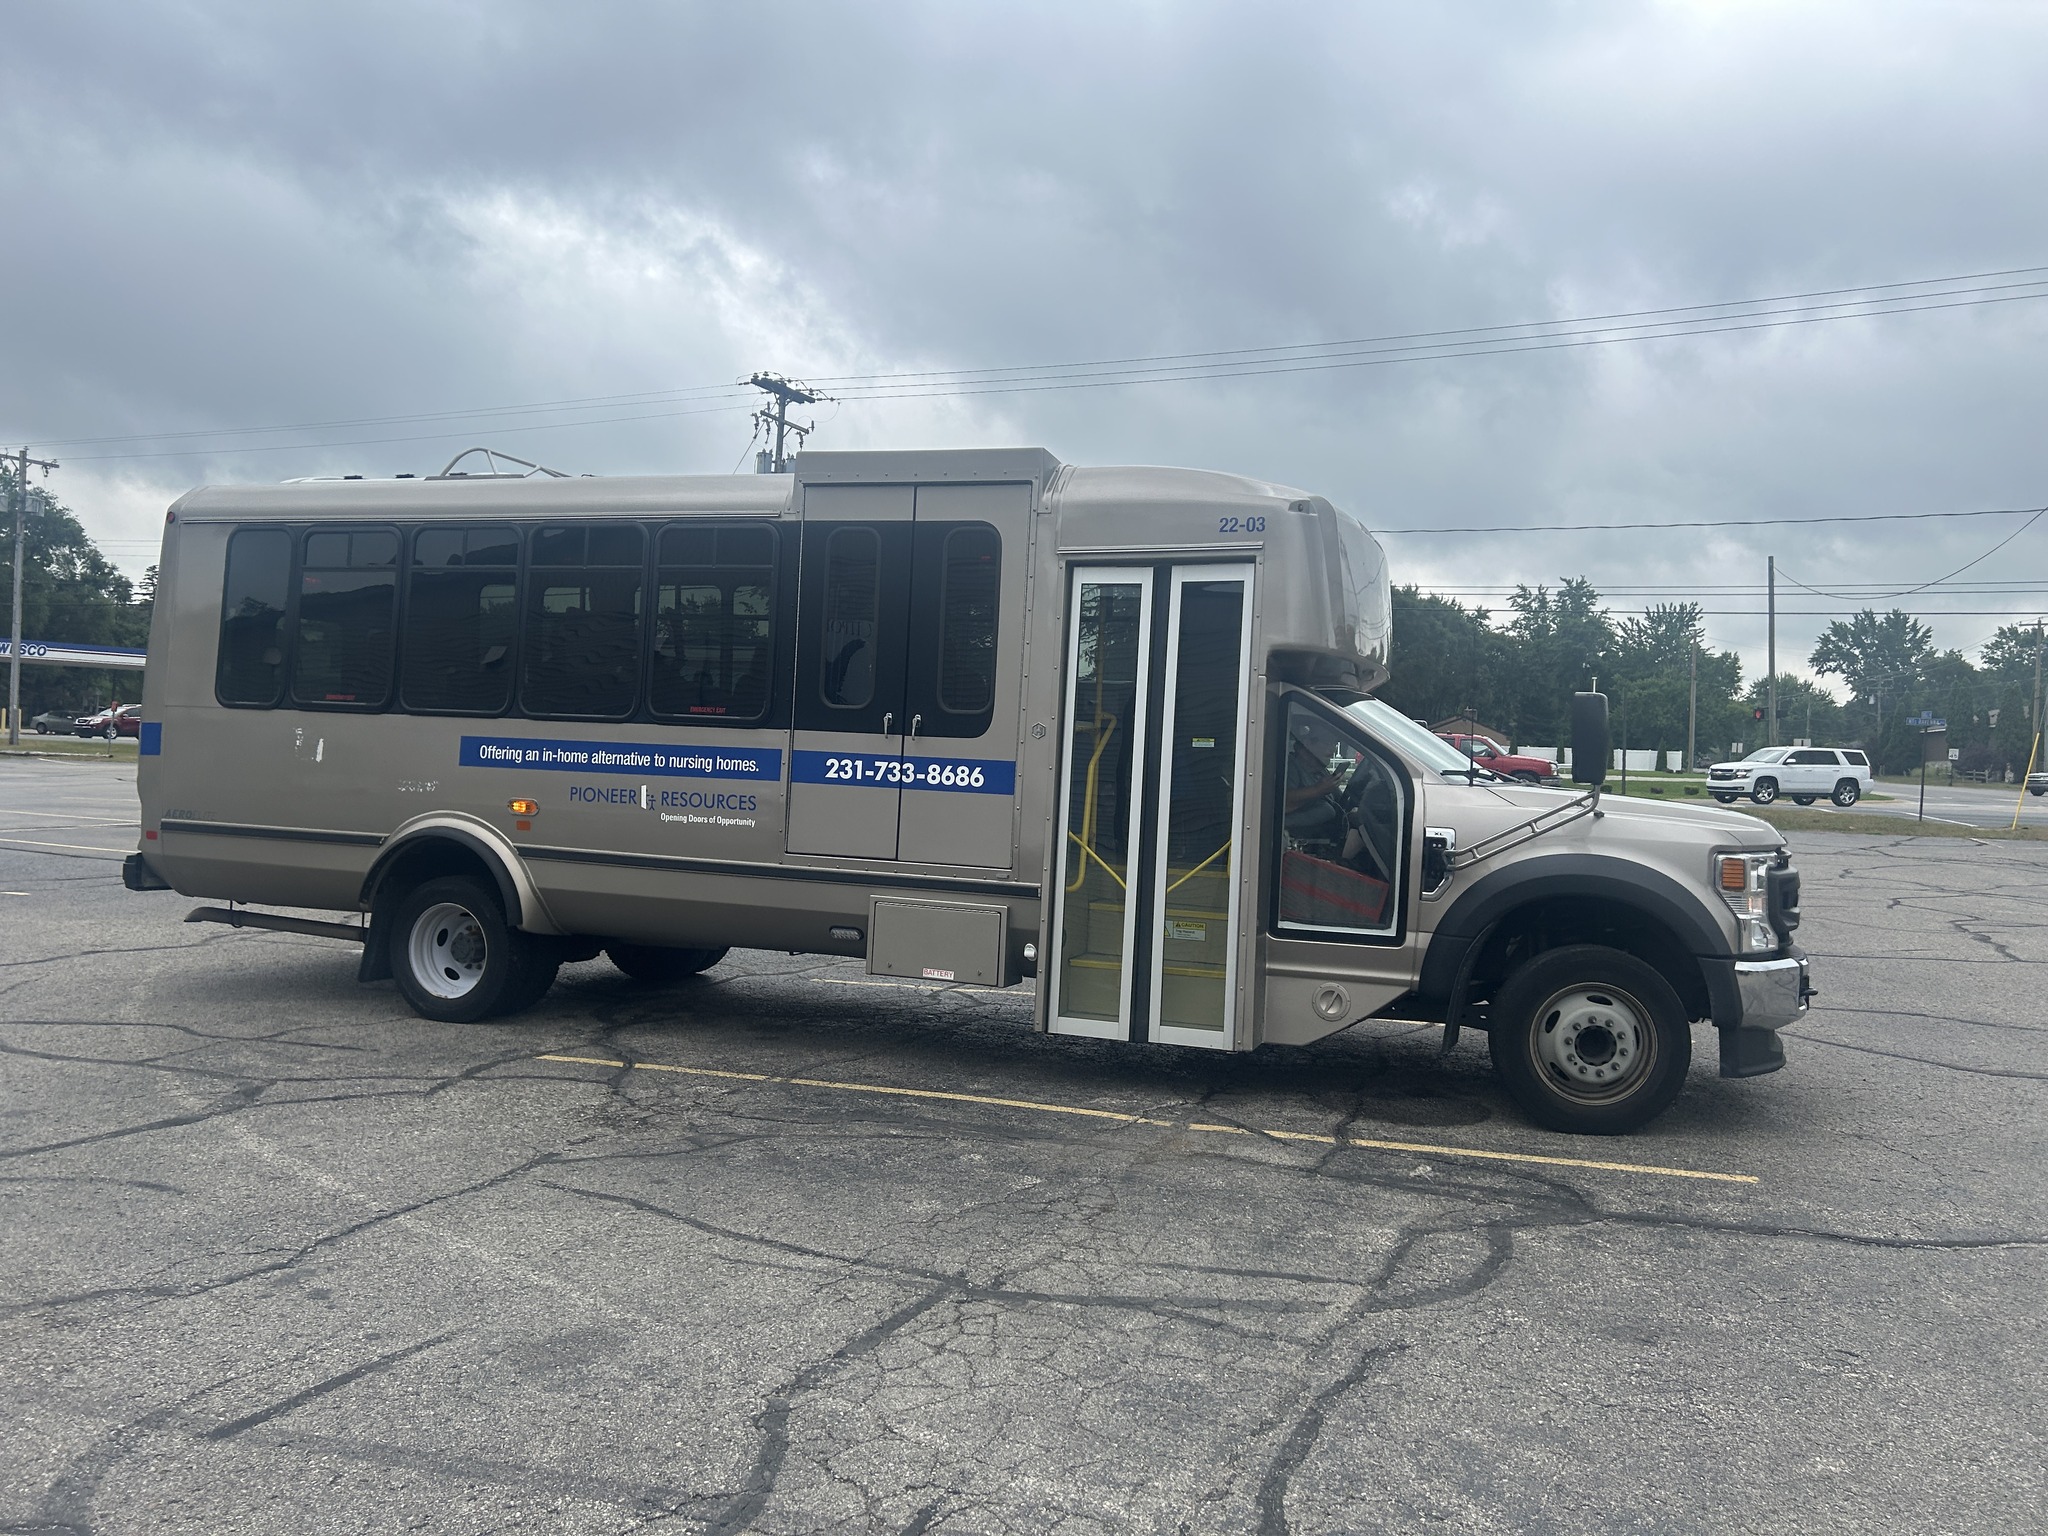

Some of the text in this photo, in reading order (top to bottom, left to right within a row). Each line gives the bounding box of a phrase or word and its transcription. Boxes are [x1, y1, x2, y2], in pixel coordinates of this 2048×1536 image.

[1219, 516, 1266, 533] 22-03
[0, 641, 47, 657] WSCO
[479, 744, 760, 773] Offering an in-home alternative to nursing homes.
[824, 758, 985, 788] 231-733-8686
[569, 786, 757, 812] PIONEER RESOURCES
[660, 812, 756, 828] Opening Doors of Opportunity
[923, 969, 954, 978] BATTERY
